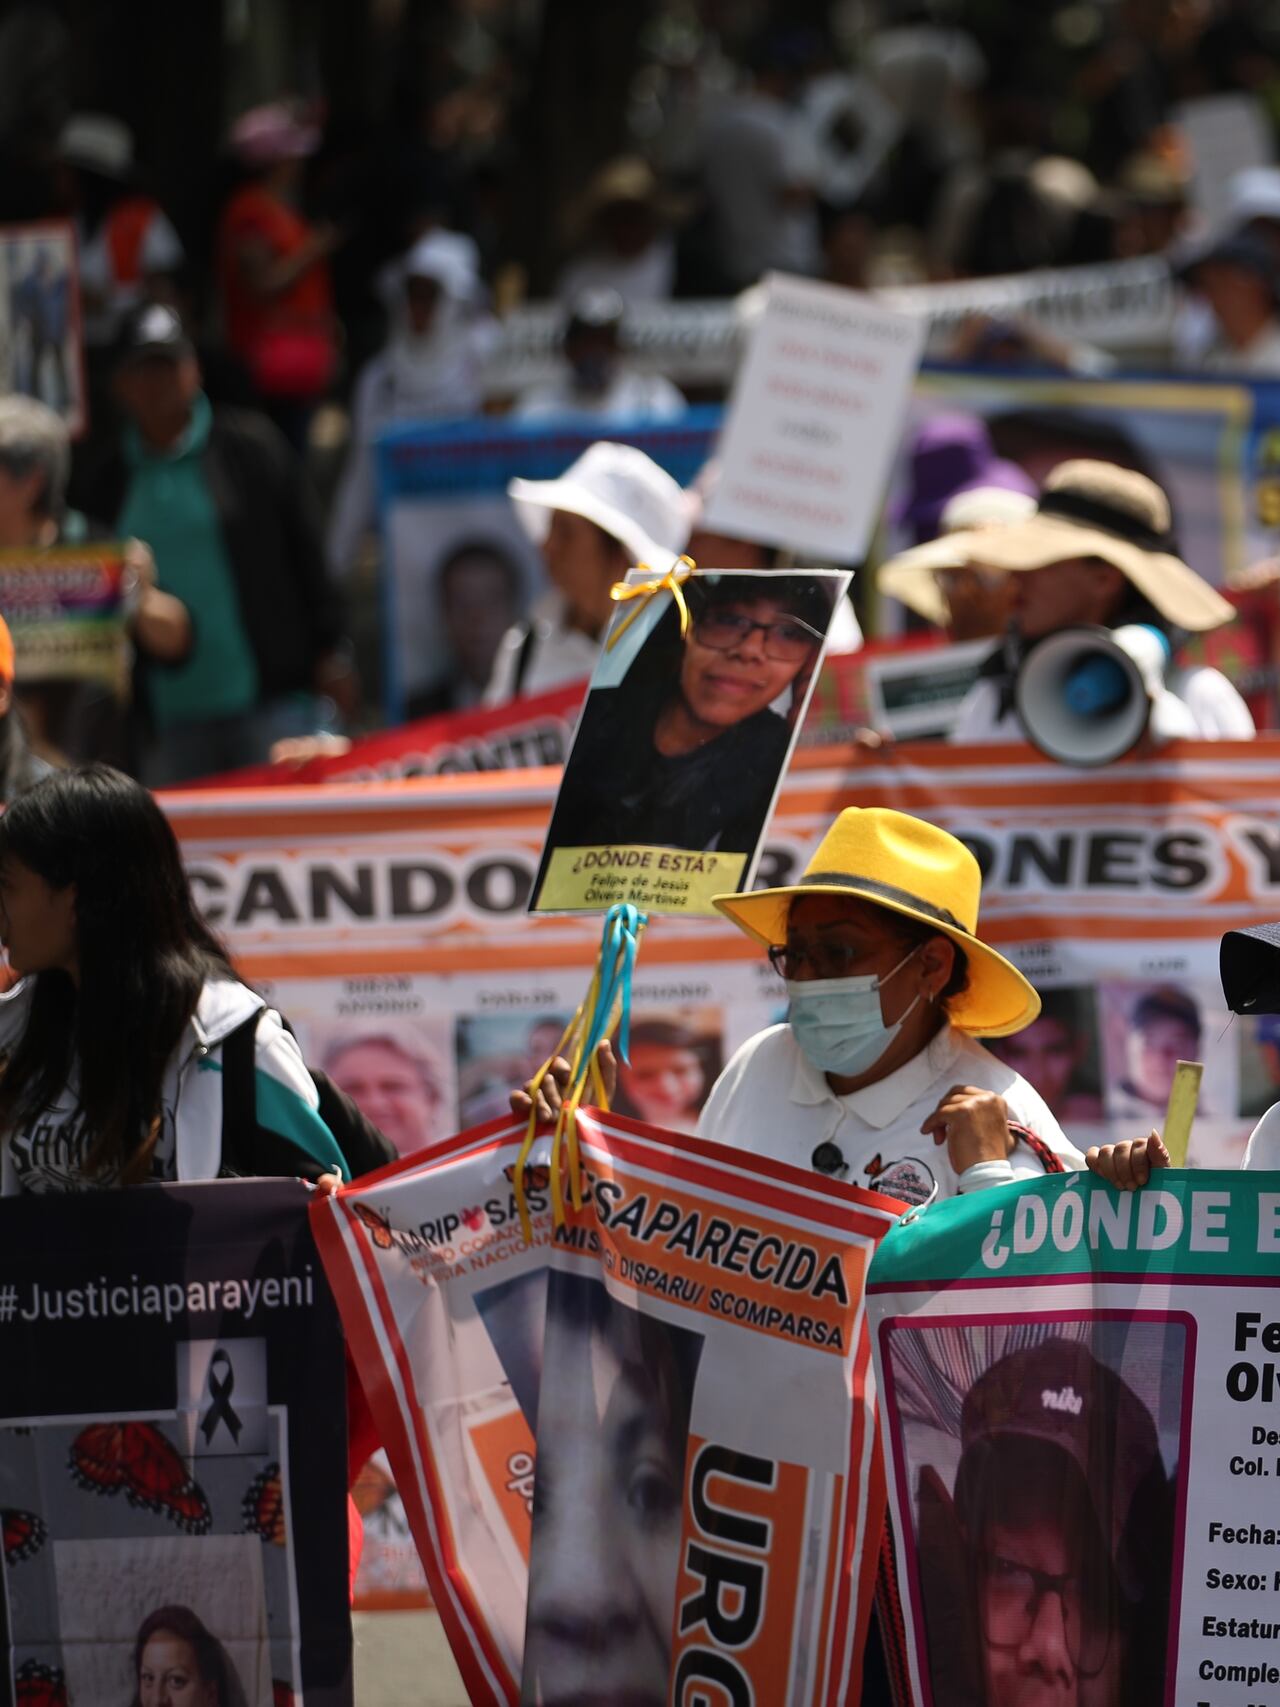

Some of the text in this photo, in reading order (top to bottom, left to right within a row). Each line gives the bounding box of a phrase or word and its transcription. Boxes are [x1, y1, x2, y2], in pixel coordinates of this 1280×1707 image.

[571, 845, 719, 875] ¿DÓNDE ESTÁ?
[590, 873, 628, 889] Felipe
[631, 874, 649, 887] de
[584, 887, 624, 903] Olvera
[980, 1172, 1231, 1270] ¿DÓNDE
[0, 1264, 315, 1324] #Justiciaparayeni
[620, 1256, 706, 1305] DISPARU/
[708, 1286, 845, 1351] SCOMPARSA
[1228, 1455, 1269, 1477] Col.
[1205, 1567, 1268, 1592] Sexo:
